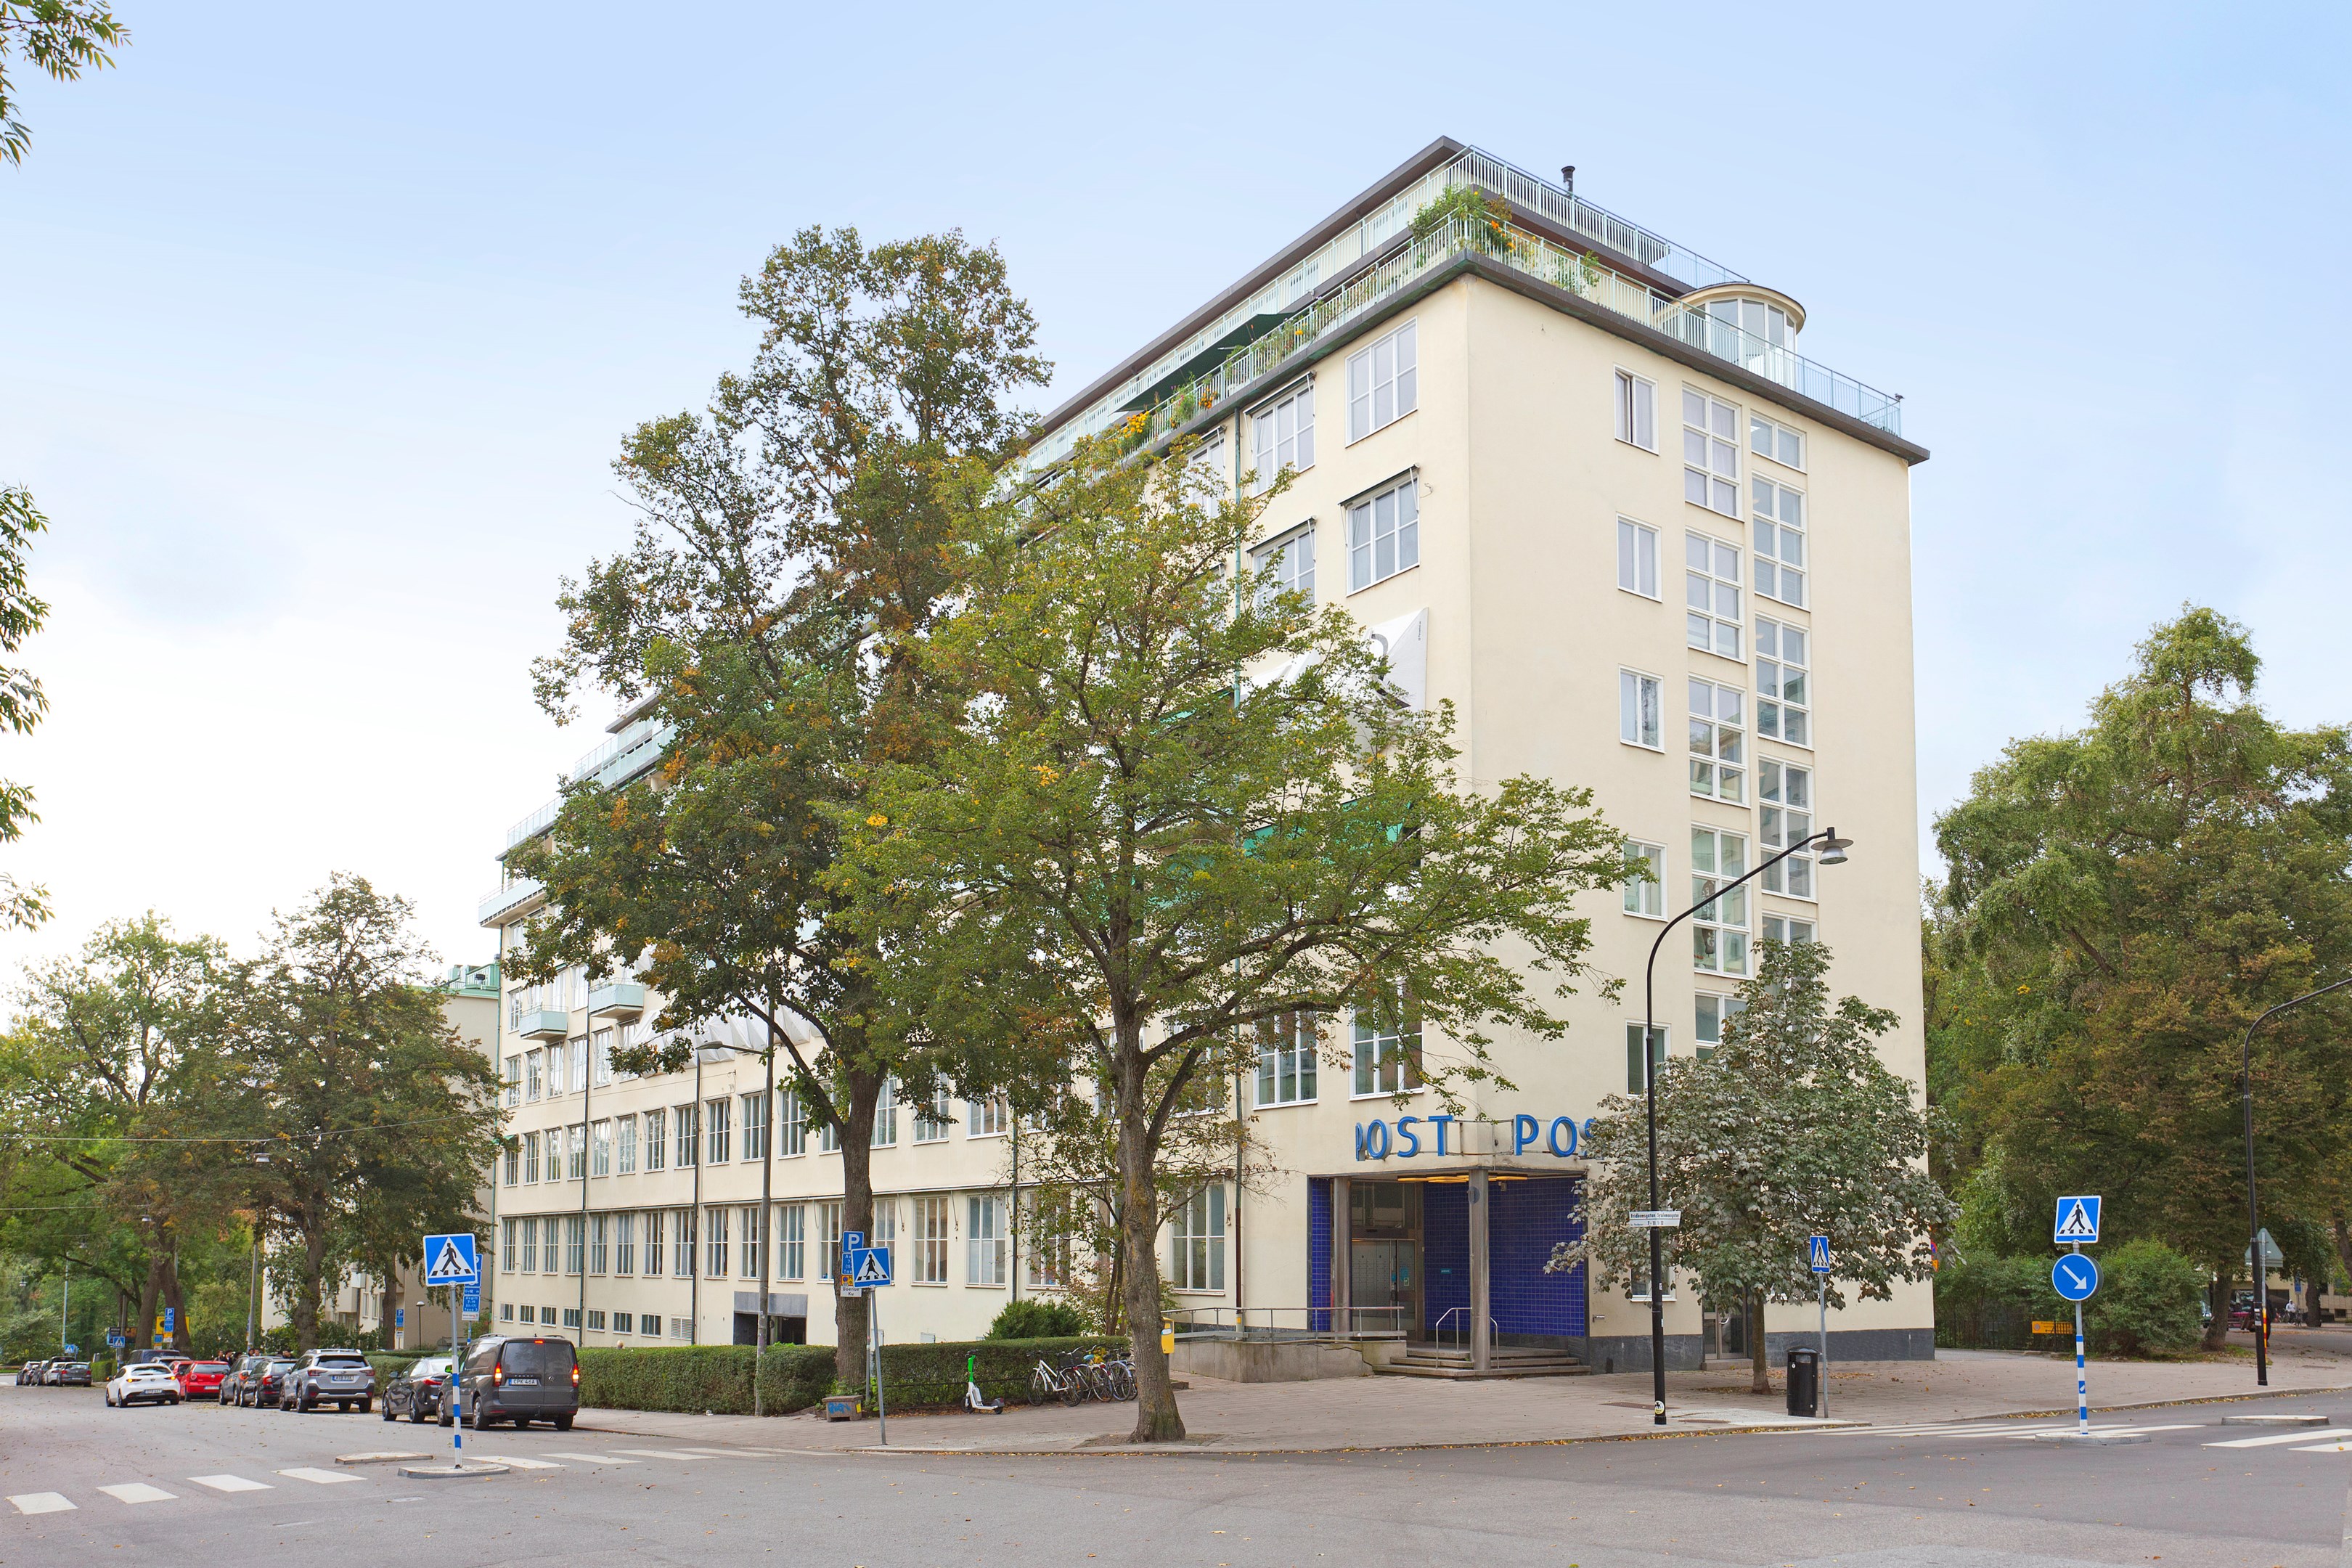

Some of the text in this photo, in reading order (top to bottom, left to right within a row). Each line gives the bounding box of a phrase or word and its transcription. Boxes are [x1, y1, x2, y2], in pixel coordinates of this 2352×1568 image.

[1355, 1114, 1455, 1161] POST
[1514, 1114, 1597, 1160] PO
[848, 1233, 860, 1251] P
